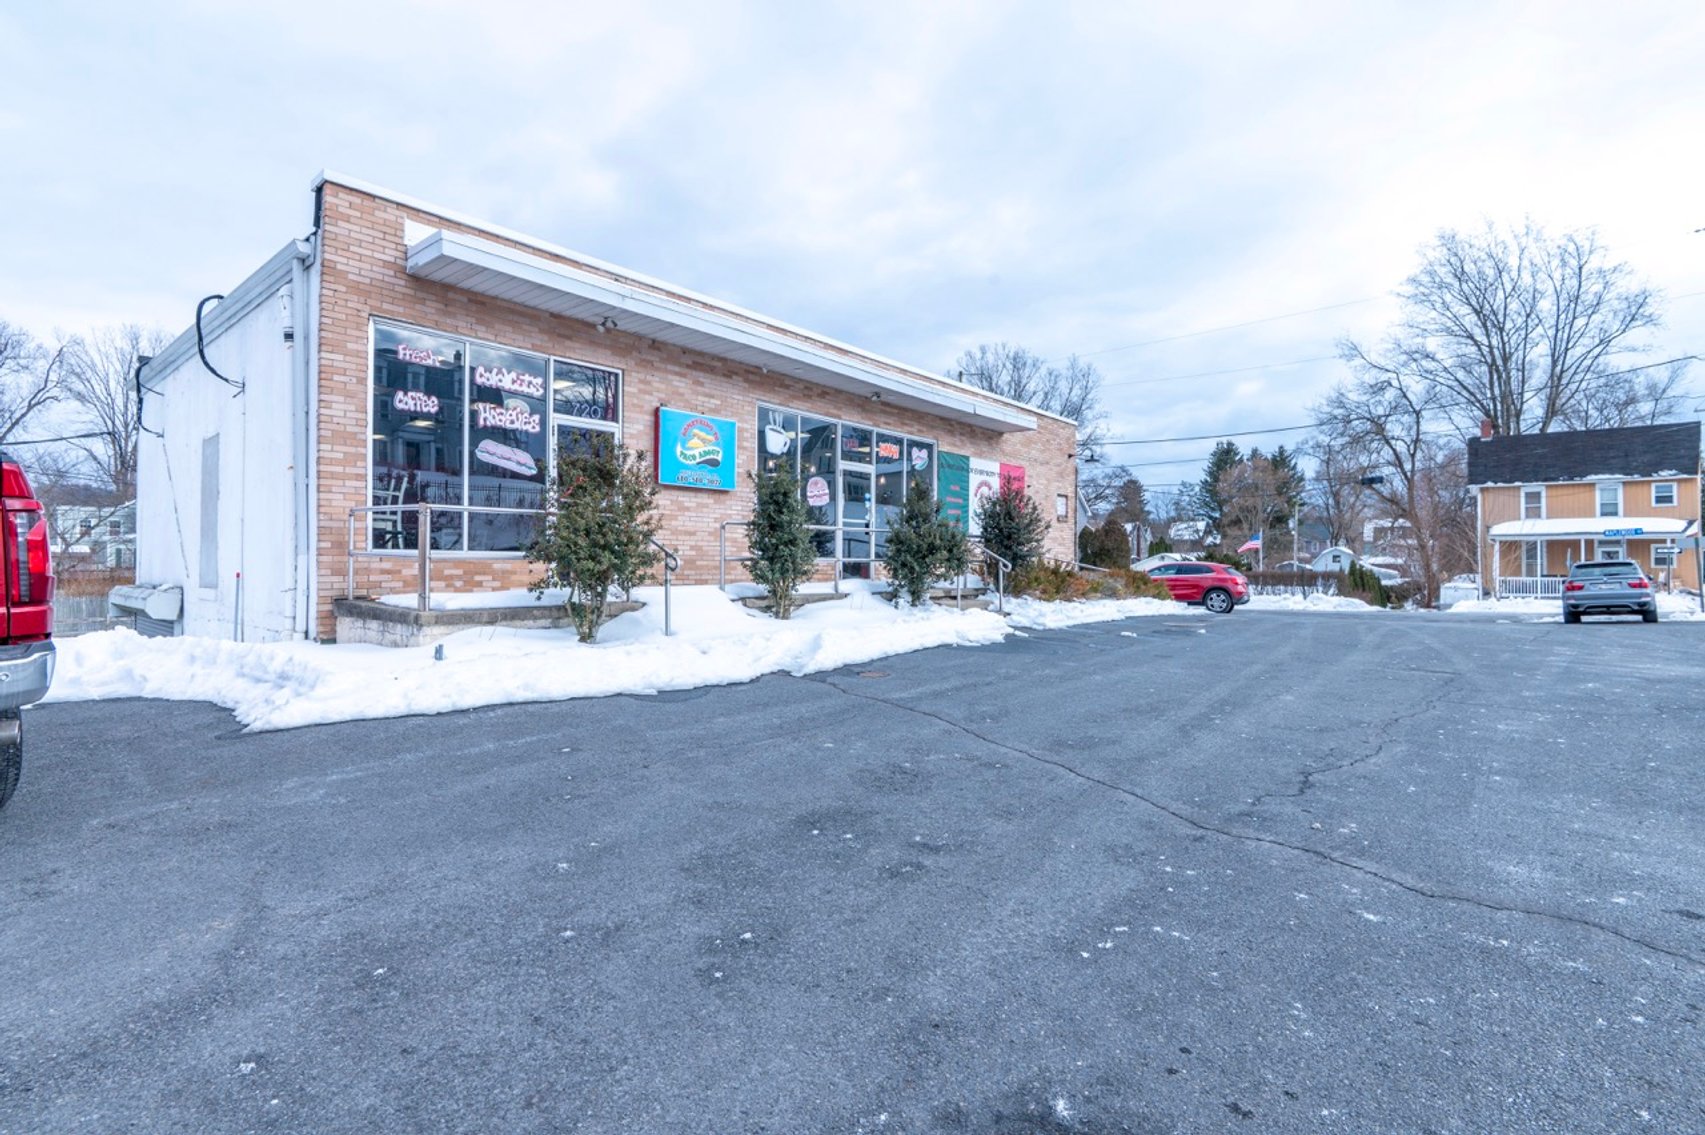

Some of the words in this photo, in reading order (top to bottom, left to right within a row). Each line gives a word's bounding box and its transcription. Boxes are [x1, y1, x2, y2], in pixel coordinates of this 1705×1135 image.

[398, 344, 439, 366] Fresh
[394, 389, 439, 414] Coffee
[571, 402, 601, 418] 720
[478, 402, 541, 433] Hoagies
